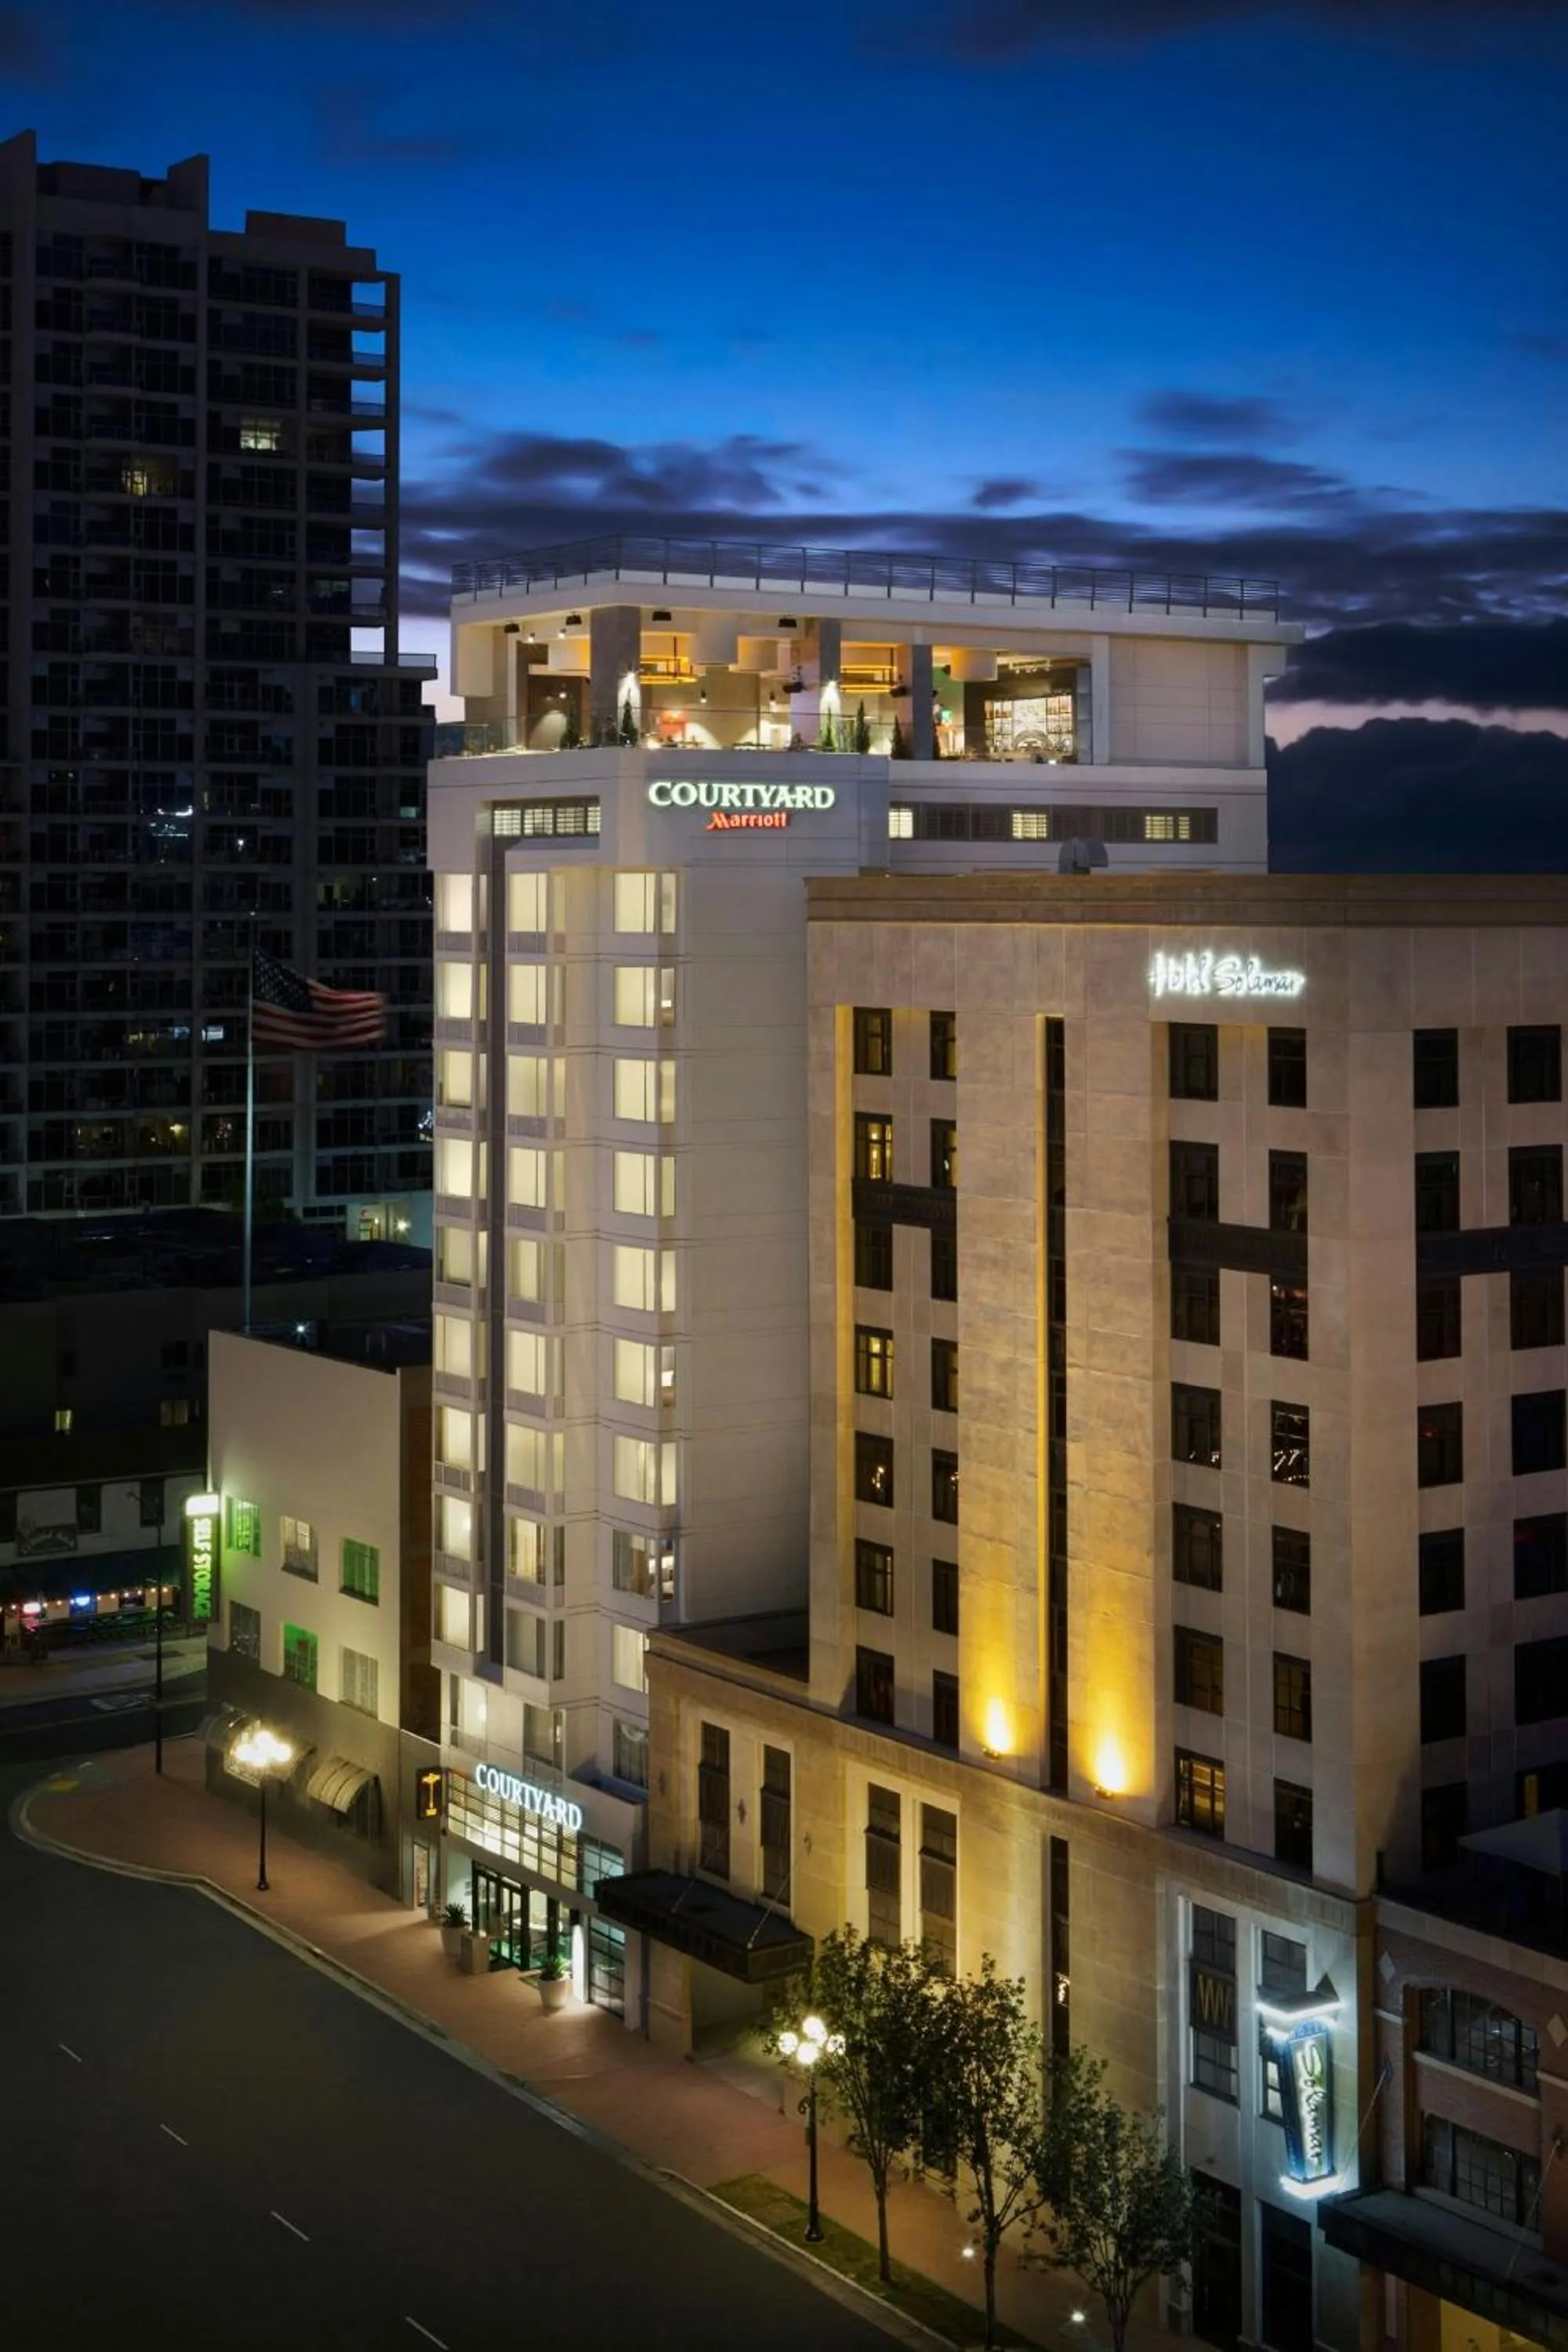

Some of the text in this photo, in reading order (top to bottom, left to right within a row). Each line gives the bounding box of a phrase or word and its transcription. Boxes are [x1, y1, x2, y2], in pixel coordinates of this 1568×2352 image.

[648, 782, 835, 808] COURTYARD
[706, 811, 787, 829] Marriott
[193, 1517, 212, 1618] SELF STORAGE
[476, 1764, 583, 1830] COURTYARD
[1301, 2041, 1327, 2161] Solamar
